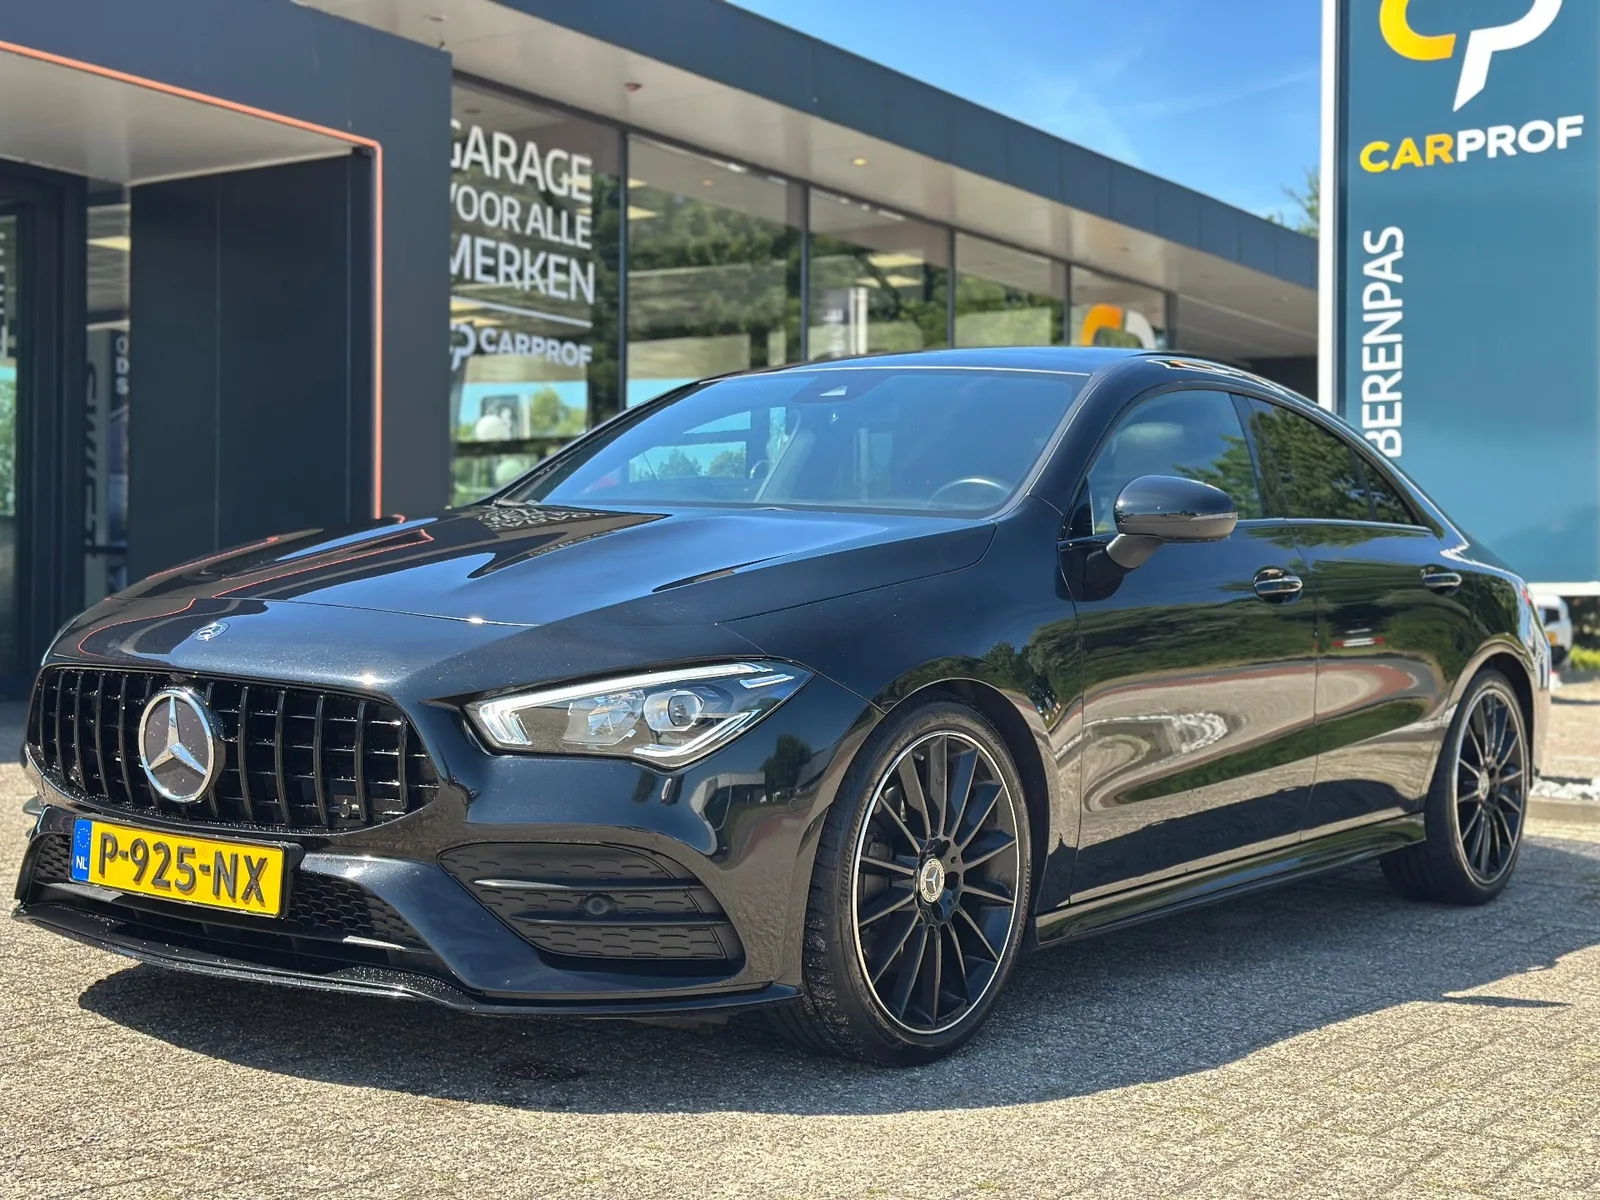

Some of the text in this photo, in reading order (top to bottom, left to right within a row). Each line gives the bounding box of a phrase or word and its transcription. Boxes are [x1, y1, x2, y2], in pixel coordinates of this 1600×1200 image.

[1359, 114, 1584, 173] CARPROF
[450, 182, 592, 250] OOR ALLE
[479, 327, 592, 367] CARPROF
[1361, 226, 1404, 458] BERENPAS
[76, 855, 88, 871] NL
[99, 831, 268, 907] P-925-NX
